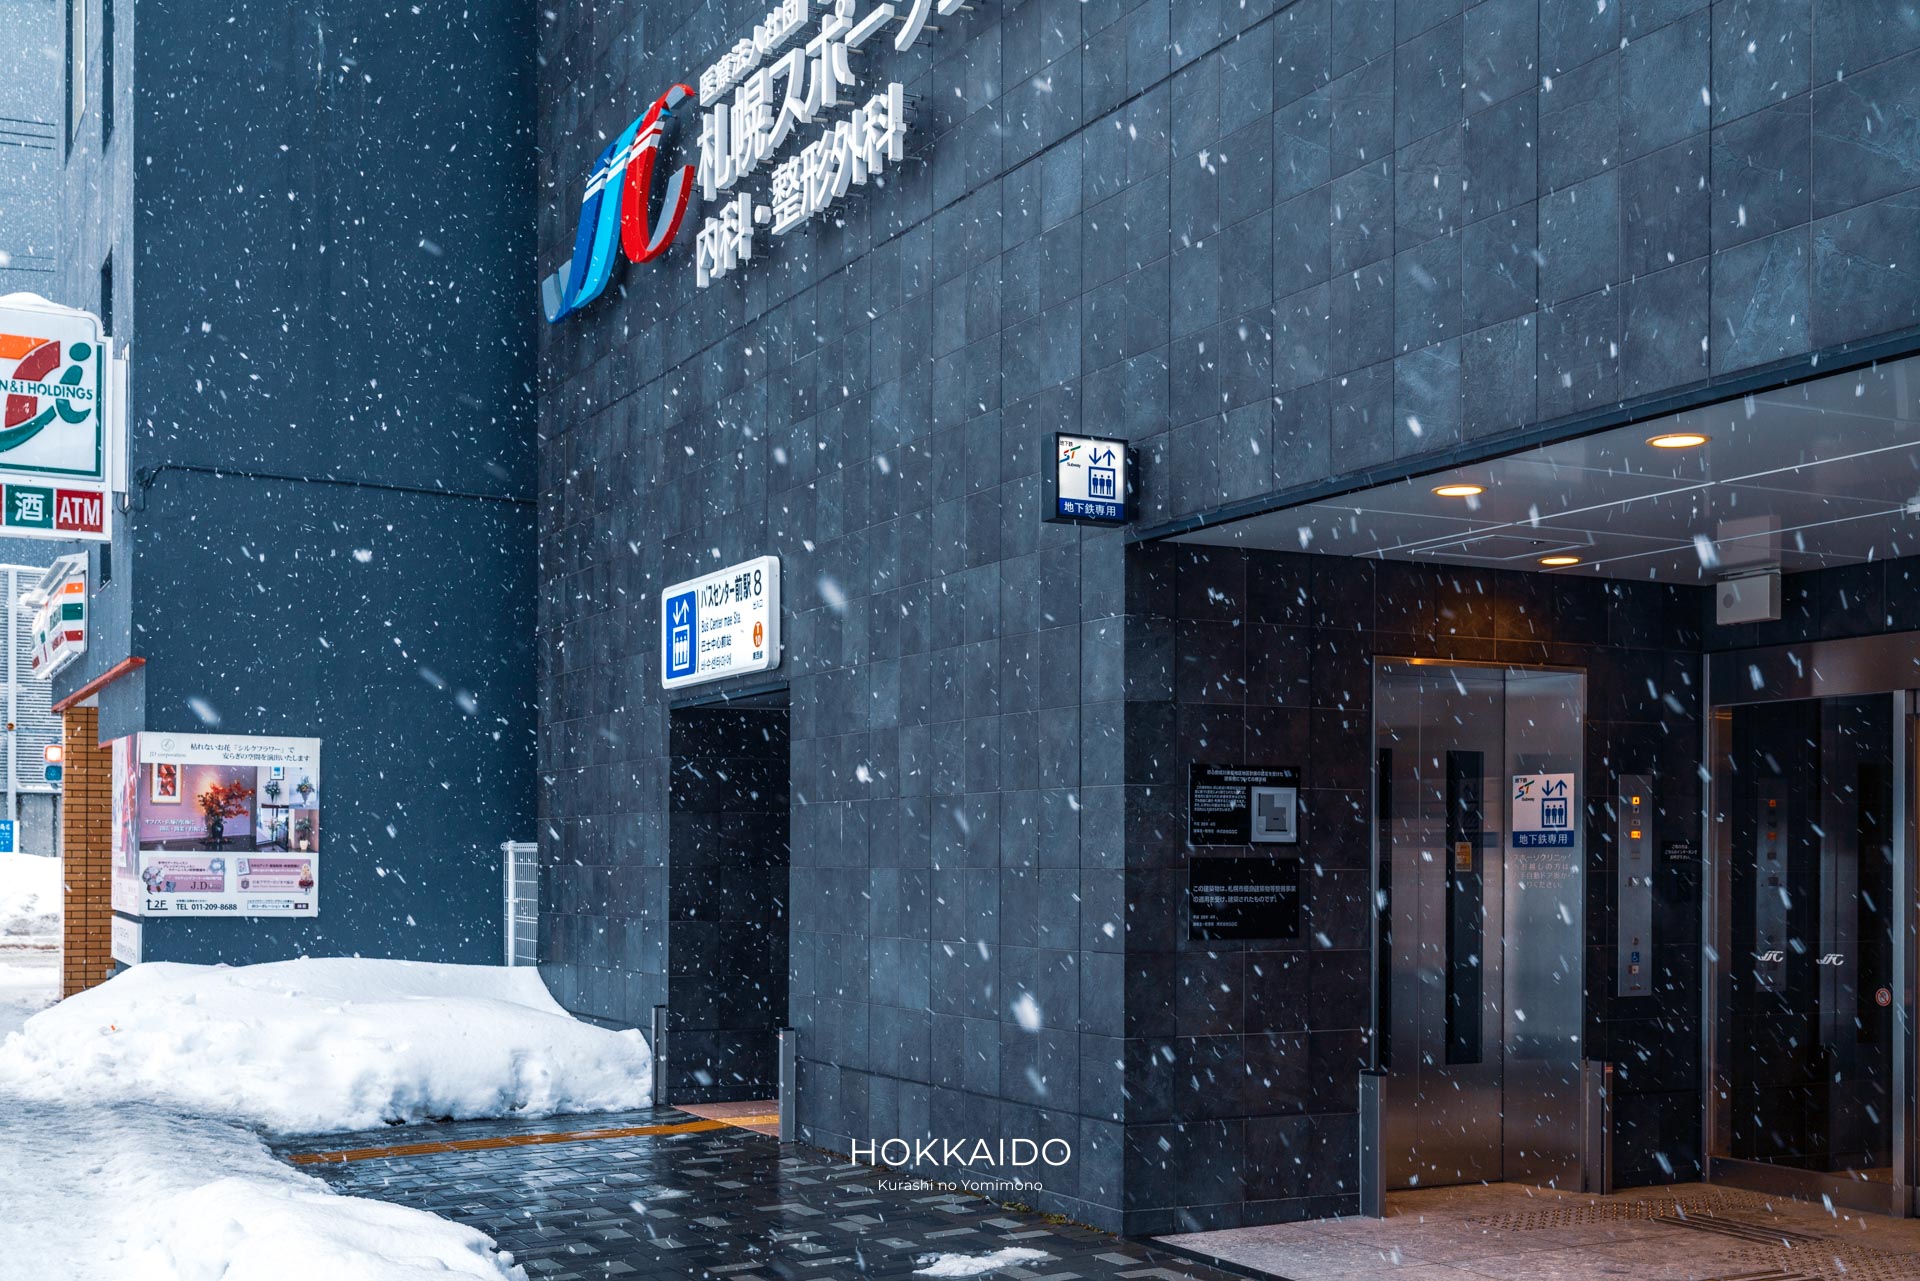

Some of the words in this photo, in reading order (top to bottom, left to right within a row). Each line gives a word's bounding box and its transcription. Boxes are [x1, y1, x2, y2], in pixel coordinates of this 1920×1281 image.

[697, 0, 965, 201] 札幌スポー
[697, 82, 906, 288] 内科・整形外科
[28, 382, 93, 400] HOLDINGS
[15, 491, 45, 522] 酒
[58, 496, 101, 526] ATM
[1063, 501, 1116, 517] 地下鉄専用
[700, 572, 752, 608] バスセンター前駅
[753, 569, 762, 596] 8
[701, 619, 709, 632] Bus
[710, 616, 723, 631] Center
[1518, 833, 1568, 845] 地下鉄専用
[154, 900, 167, 908] 2F
